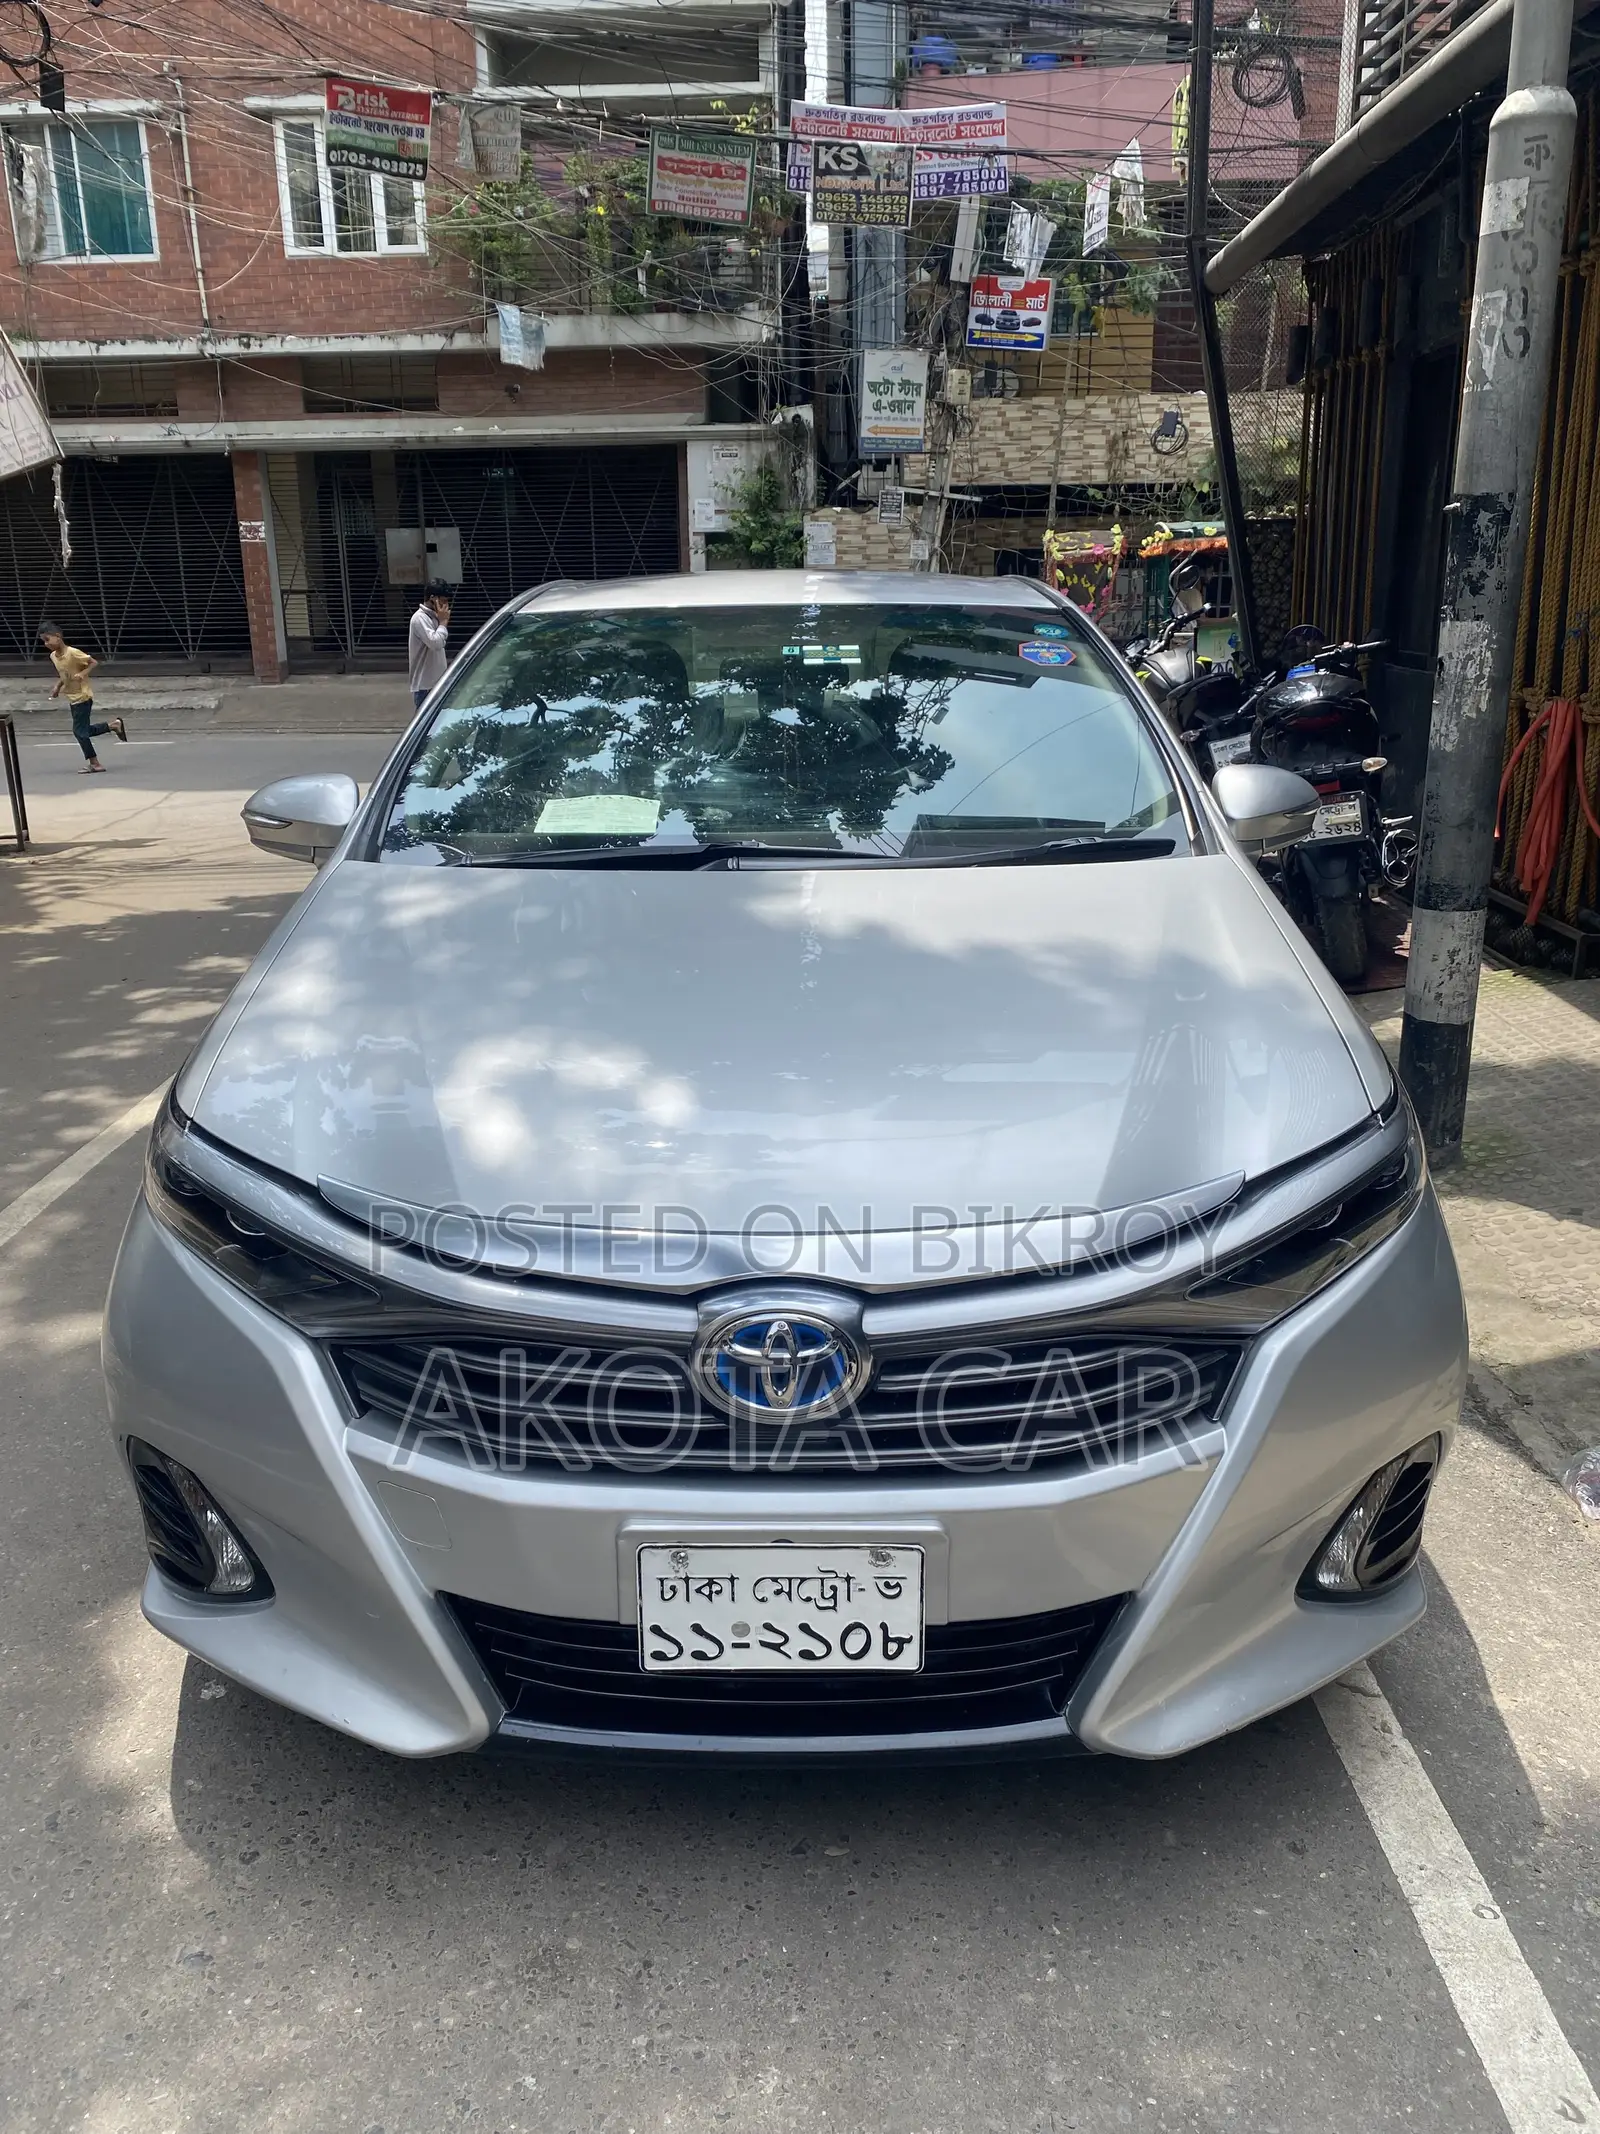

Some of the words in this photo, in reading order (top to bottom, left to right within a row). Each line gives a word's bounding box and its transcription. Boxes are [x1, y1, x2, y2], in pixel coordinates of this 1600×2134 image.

[332, 84, 388, 111] Brisk
[356, 106, 390, 116] SYSTEMS
[390, 110, 425, 120] INTERNET
[852, 126, 894, 140] সংযোগ
[961, 121, 1003, 138] সংযোগ
[329, 149, 424, 176] 01705-403875
[817, 145, 859, 171] KS
[815, 176, 876, 191] Network
[816, 192, 856, 203] 09652
[860, 194, 908, 204] 345678
[816, 201, 857, 212] 09652
[861, 203, 907, 214] 525252
[973, 289, 1012, 308] জিলানী
[1026, 293, 1047, 310] মার্ট
[866, 376, 895, 397] অটো
[897, 377, 924, 398] স্টার
[872, 398, 916, 416] এ-ওয়ান
[655, 1572, 740, 1604] ঢাকা
[649, 1621, 914, 1662] ১১-২১০৮
